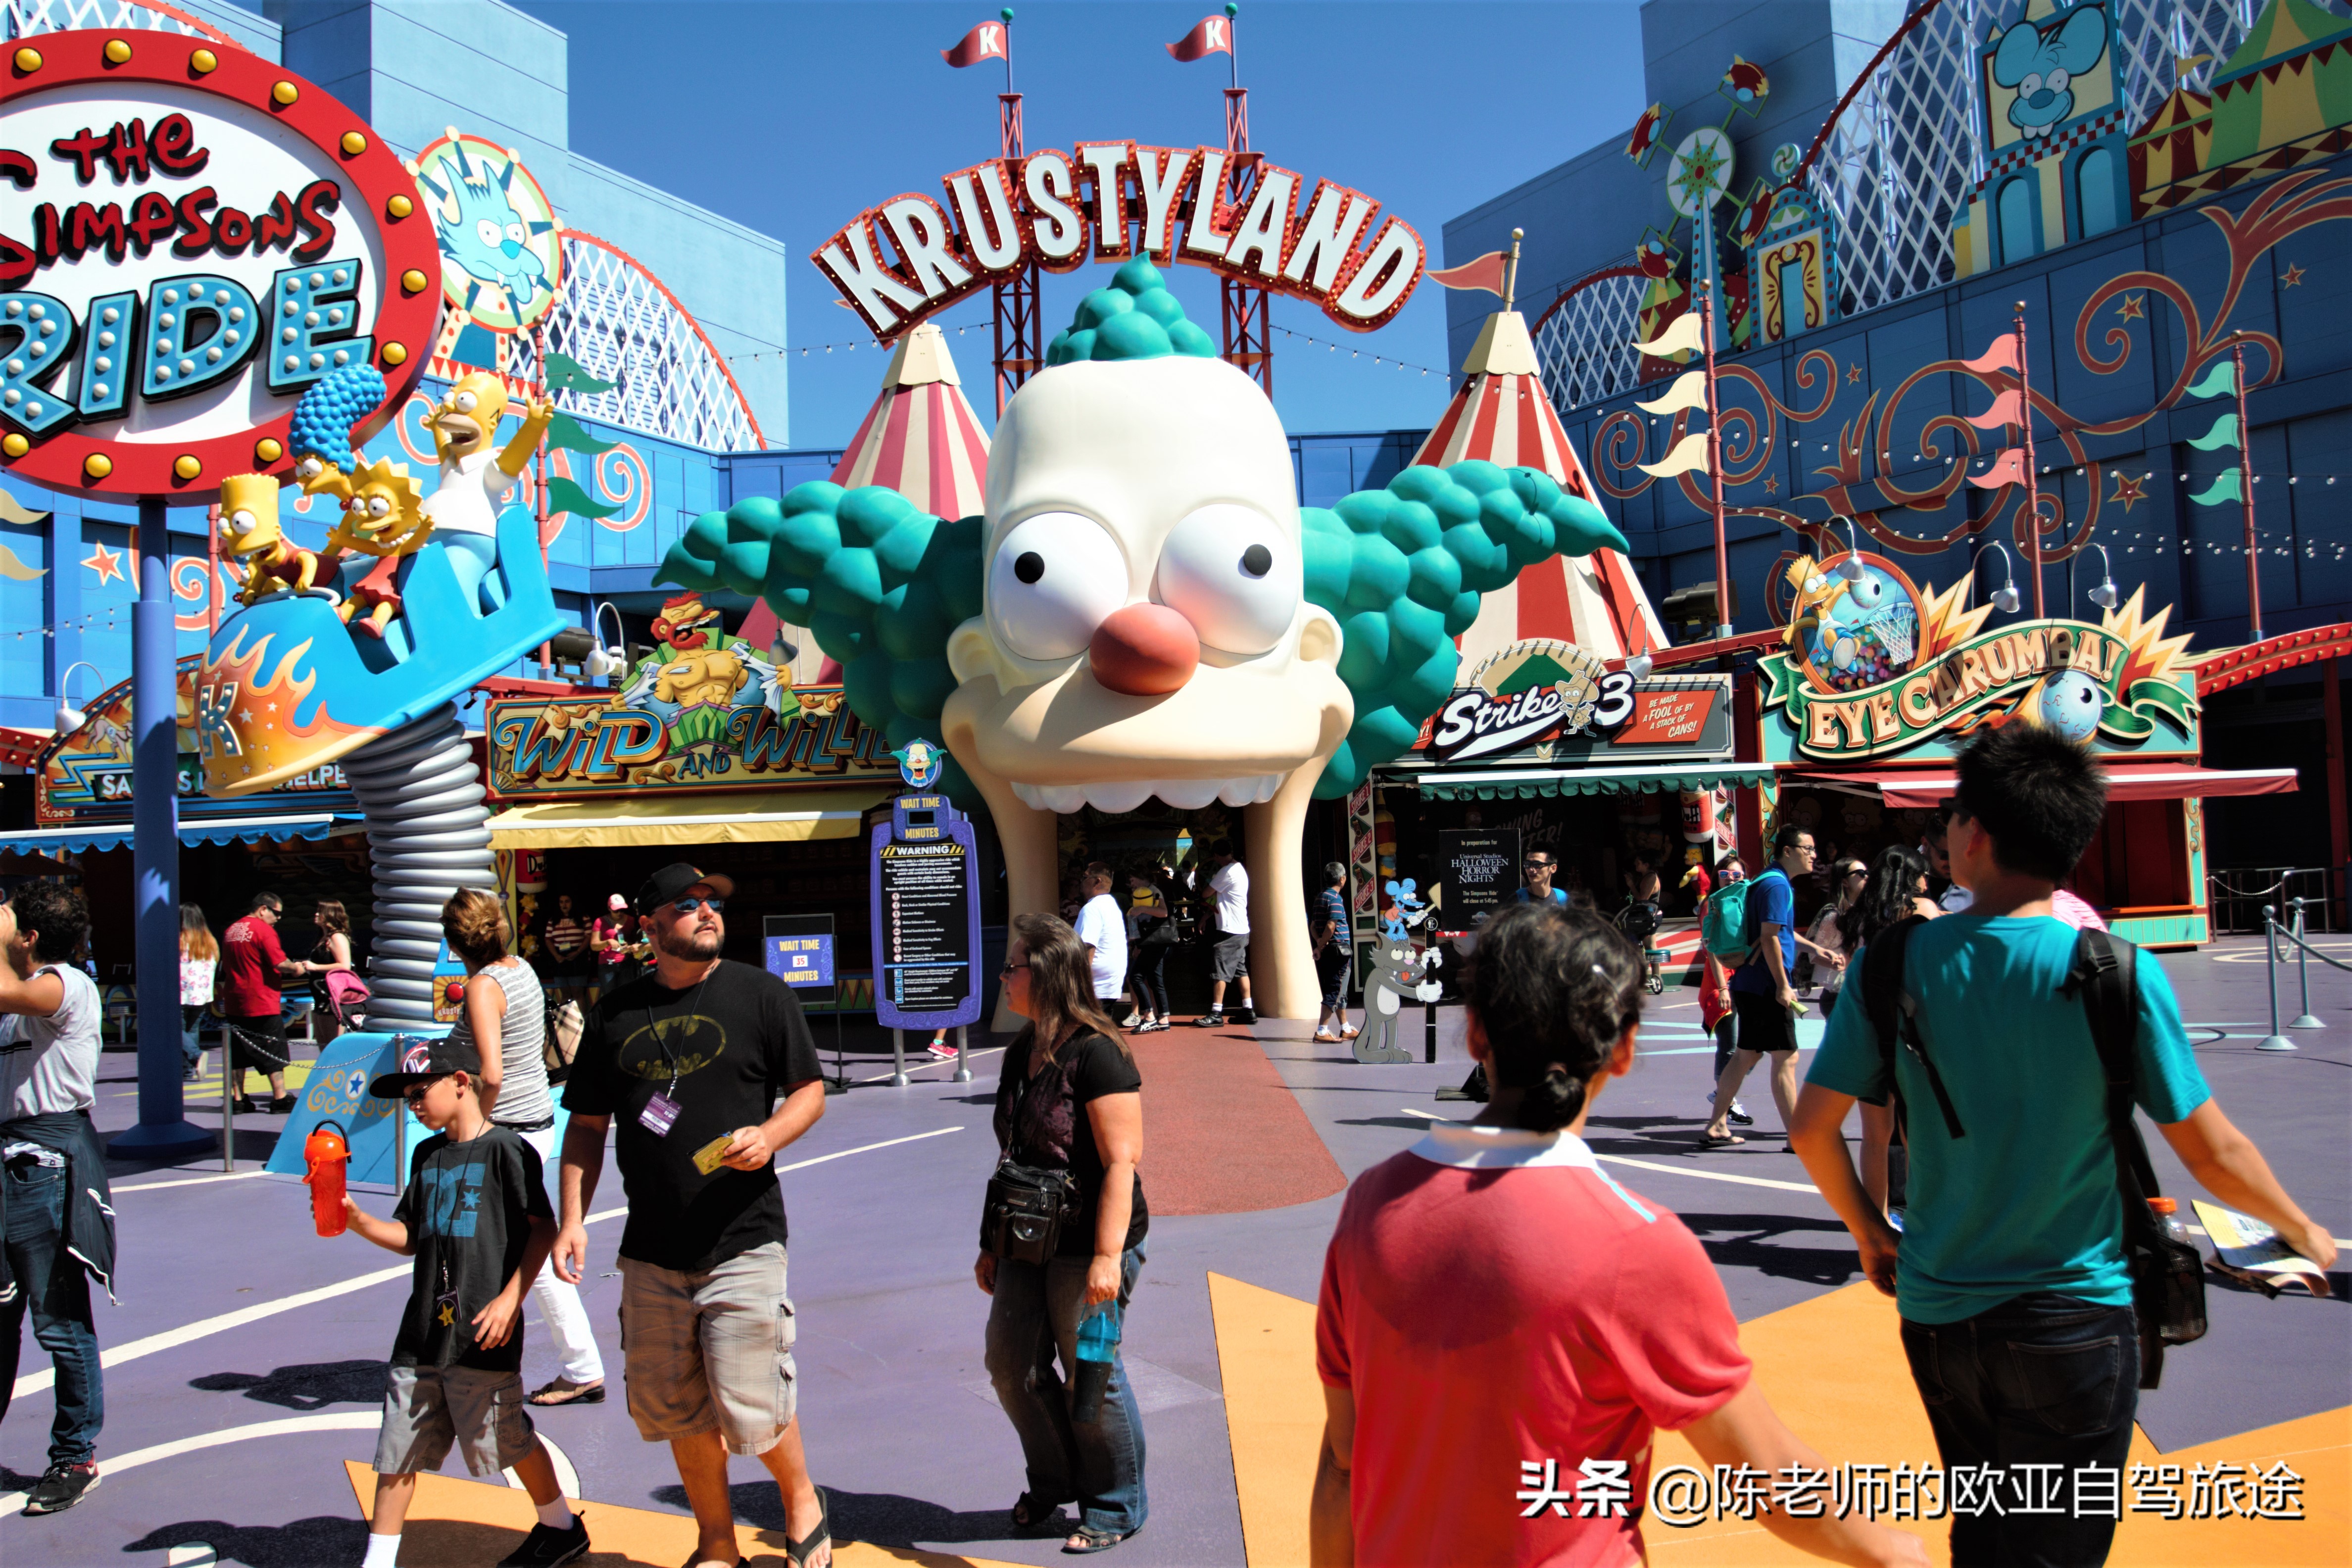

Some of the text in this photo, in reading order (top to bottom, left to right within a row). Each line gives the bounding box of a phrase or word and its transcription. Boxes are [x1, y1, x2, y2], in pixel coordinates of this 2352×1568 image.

[979, 25, 1000, 56] K
[1205, 19, 1225, 50] K
[814, 141, 1423, 344] KRUSTYLAND
[1808, 626, 2124, 750] EYE CARUMBA!
[1435, 673, 1633, 746] Strike 3
[1649, 694, 1678, 708] BE MADE
[1649, 705, 1672, 721] FOOL
[1675, 705, 1683, 714] OF
[1685, 702, 1694, 712] BY
[1656, 717, 1676, 728] STACK
[1668, 721, 1698, 737] CANS!
[678, 746, 732, 780] AND
[900, 797, 940, 809] WAIT TIME
[1351, 790, 1365, 813] STRIKE
[905, 827, 939, 839] MINUTES
[1716, 822, 1730, 842] STRIKE
[896, 845, 949, 855] WARNING
[1353, 836, 1368, 861] STRIKE
[1452, 859, 1509, 867] HALLOWEEN
[1462, 866, 1500, 875] HORROR
[1459, 875, 1494, 883] NIGHTS
[1356, 883, 1370, 909] STRIKE
[779, 939, 820, 951] WAIT TIME
[784, 970, 819, 982] MINUTES
